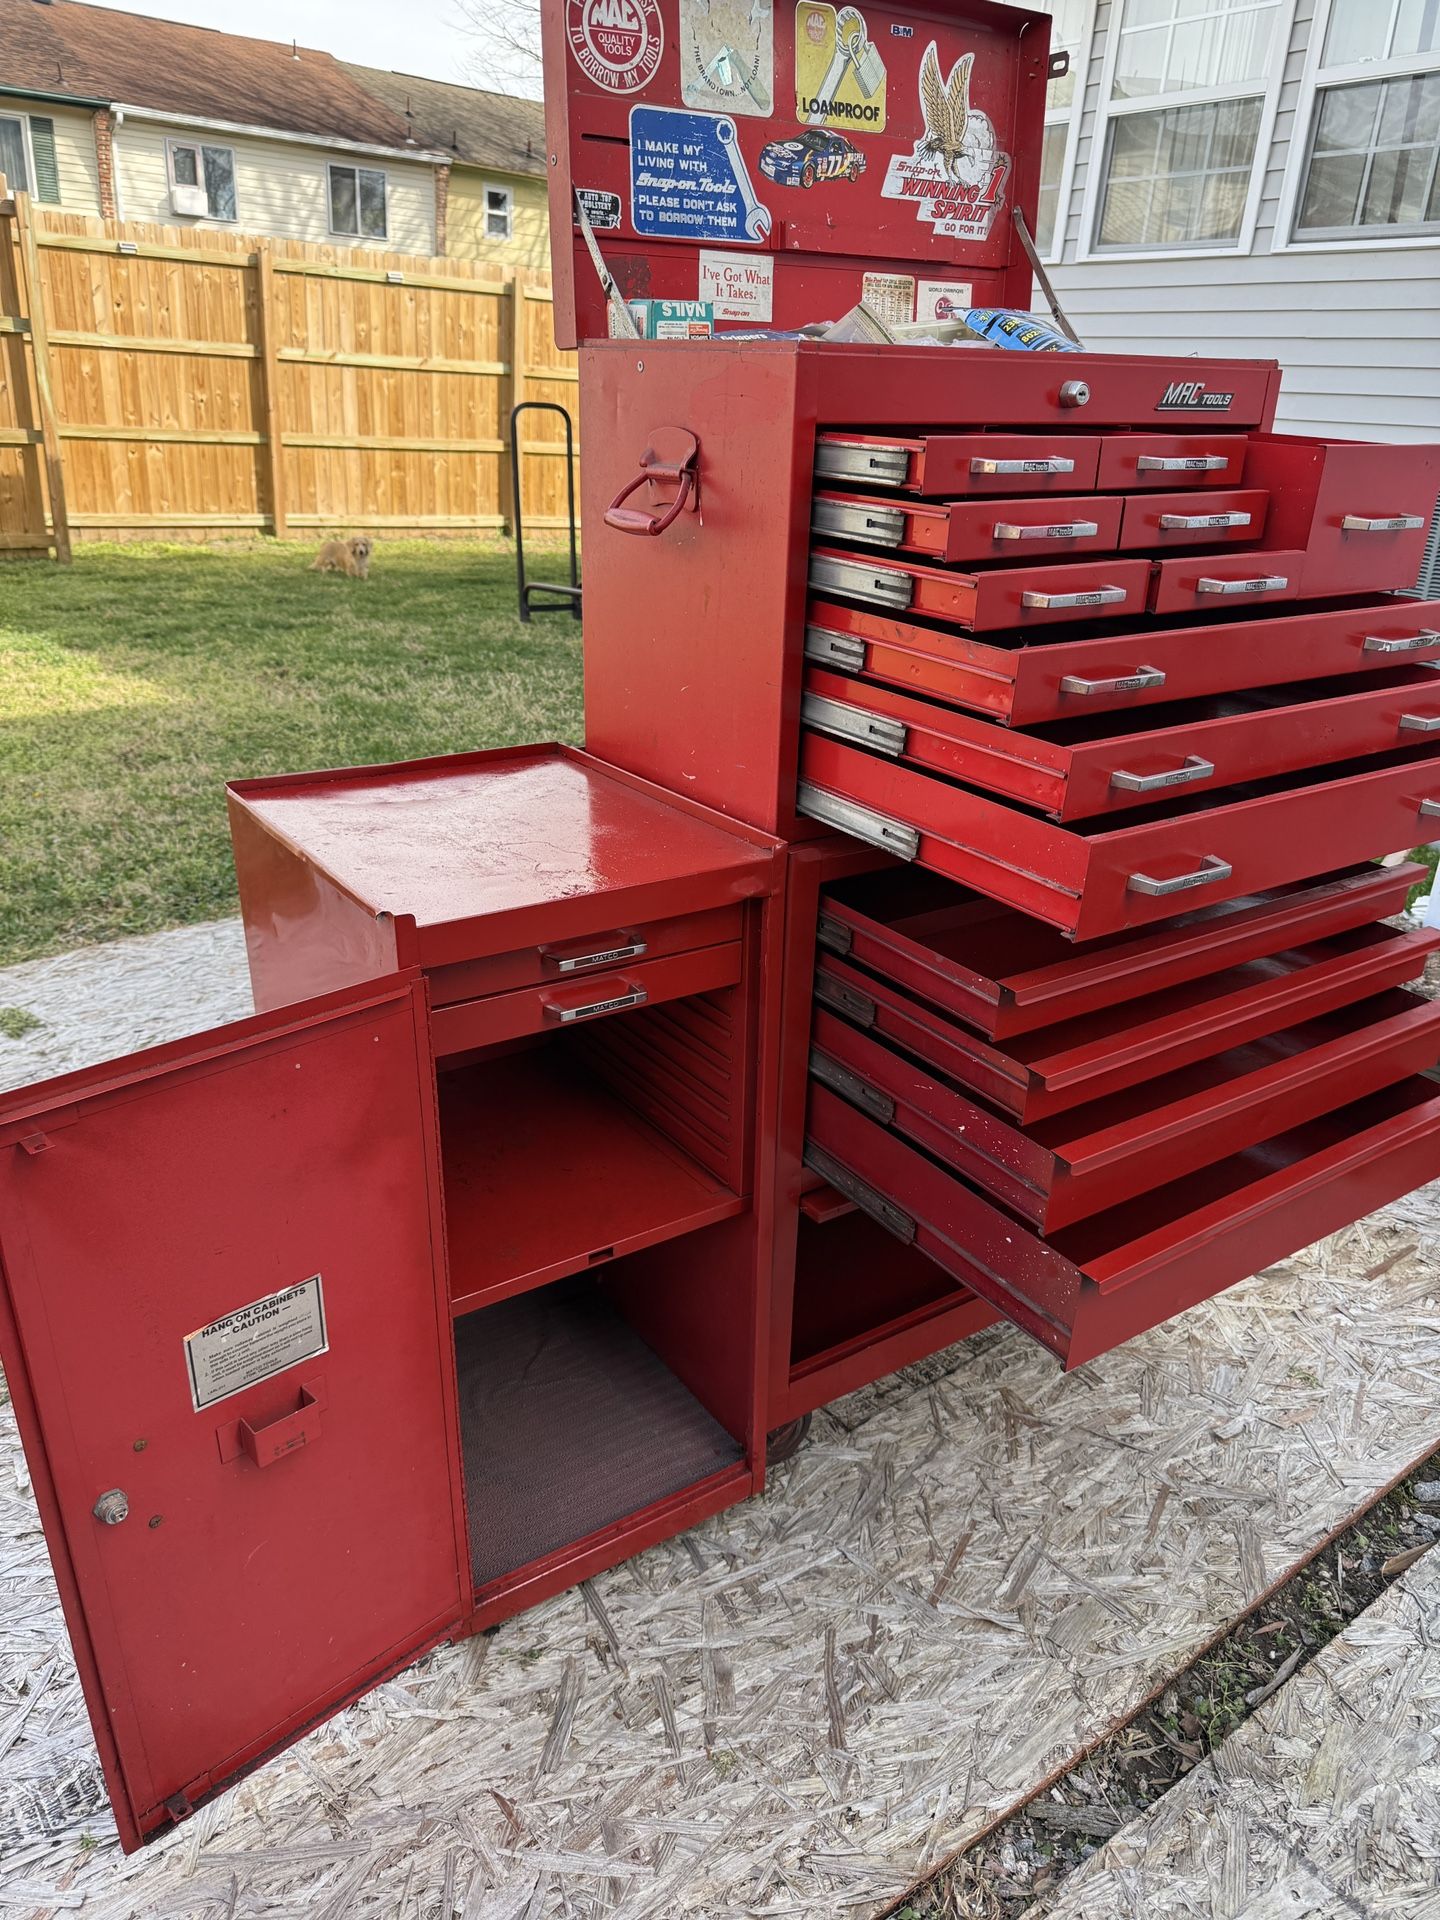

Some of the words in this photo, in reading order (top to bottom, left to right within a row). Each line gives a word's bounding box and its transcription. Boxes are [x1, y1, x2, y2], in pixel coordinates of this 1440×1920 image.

[590, 0, 639, 30] MAC
[598, 32, 635, 46] QUALITY
[570, 25, 584, 43] TO
[578, 47, 619, 87] BORROW
[623, 68, 640, 88] MY
[638, 34, 660, 75] TOOLS
[602, 43, 632, 56] TOOLS
[697, 64, 716, 90] BRAND
[802, 97, 880, 122] LOANPROOF
[637, 139, 641, 150] I
[645, 140, 679, 154] MAKE
[683, 144, 700, 156] MY
[637, 155, 674, 169] LIVING
[679, 159, 707, 173] WITH
[828, 155, 843, 177] 77
[896, 161, 941, 178] Snap-on
[636, 172, 697, 192] Snap-on
[698, 177, 737, 194] Tools
[900, 177, 980, 203] WINNING
[580, 200, 612, 210] PHOLSTERY
[584, 192, 598, 201] AUTO
[638, 194, 680, 208] PLEASE
[683, 198, 714, 210] DON'T
[715, 202, 737, 213] ASK
[638, 210, 654, 221] TO
[659, 211, 704, 225] BORROW
[706, 215, 737, 227] THEM
[931, 199, 991, 222] SPIRIT
[944, 223, 956, 232] GO
[960, 224, 974, 234] FOR
[976, 226, 987, 235] IT!
[703, 265, 720, 280] I've
[723, 267, 743, 282] Got
[744, 268, 771, 285] What
[715, 282, 723, 297] It
[726, 284, 757, 300] Takes.
[662, 302, 706, 317] NAILS
[721, 308, 750, 317] Snap-on
[1162, 382, 1205, 405] MAC
[1201, 394, 1232, 405] TOOLS
[591, 952, 618, 963] MATCO
[593, 1001, 619, 1012] MATCO
[201, 1318, 234, 1338] HANG
[235, 1311, 251, 1323] ON
[253, 1287, 306, 1314] CABINETS
[232, 1308, 280, 1334] CAUTION
